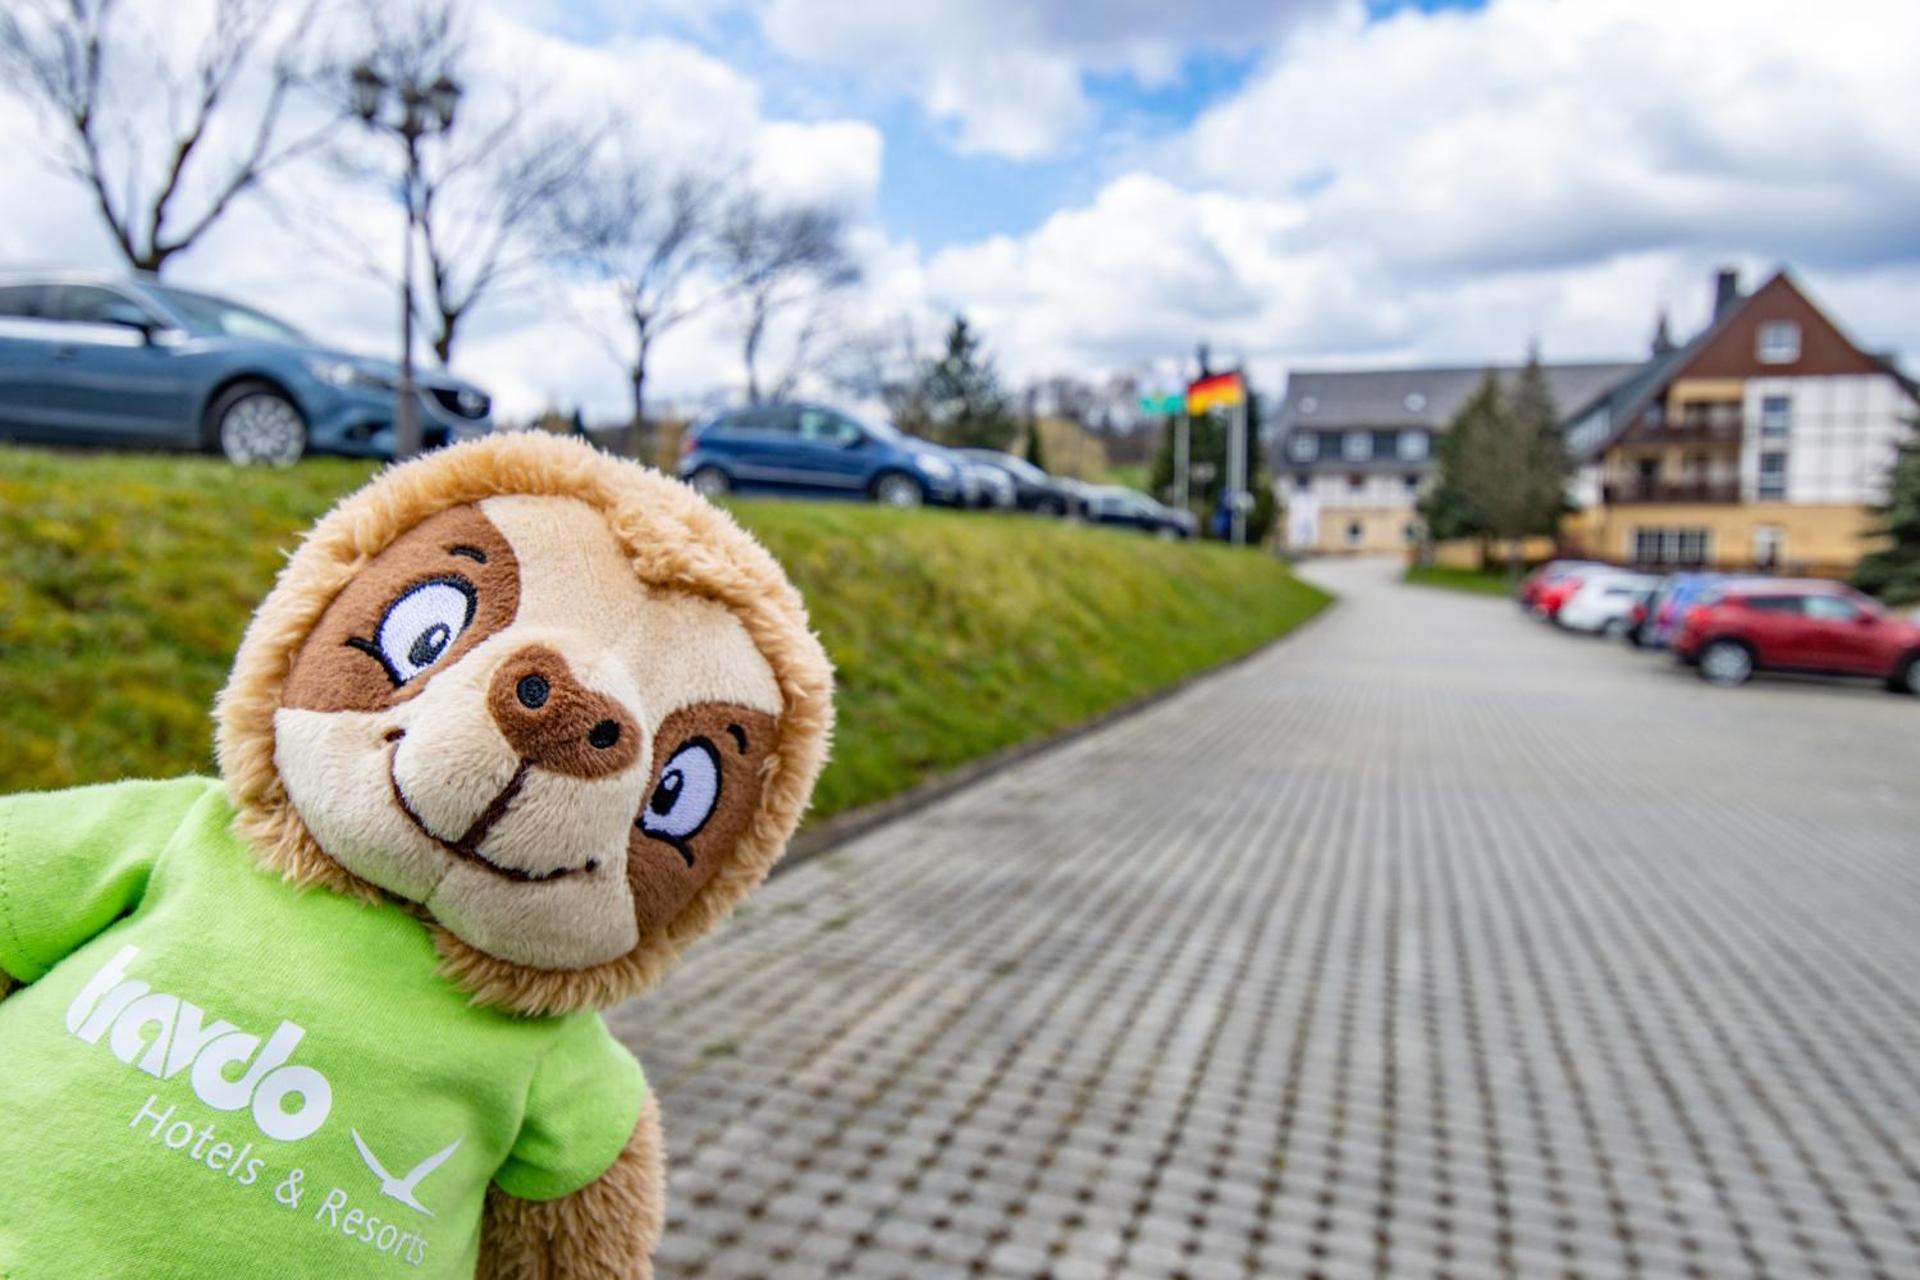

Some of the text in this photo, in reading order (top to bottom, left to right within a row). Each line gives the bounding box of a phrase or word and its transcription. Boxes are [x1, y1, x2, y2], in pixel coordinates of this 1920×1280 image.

[65, 944, 332, 1141] travdo
[129, 1094, 429, 1266] Hotels & Resorts
